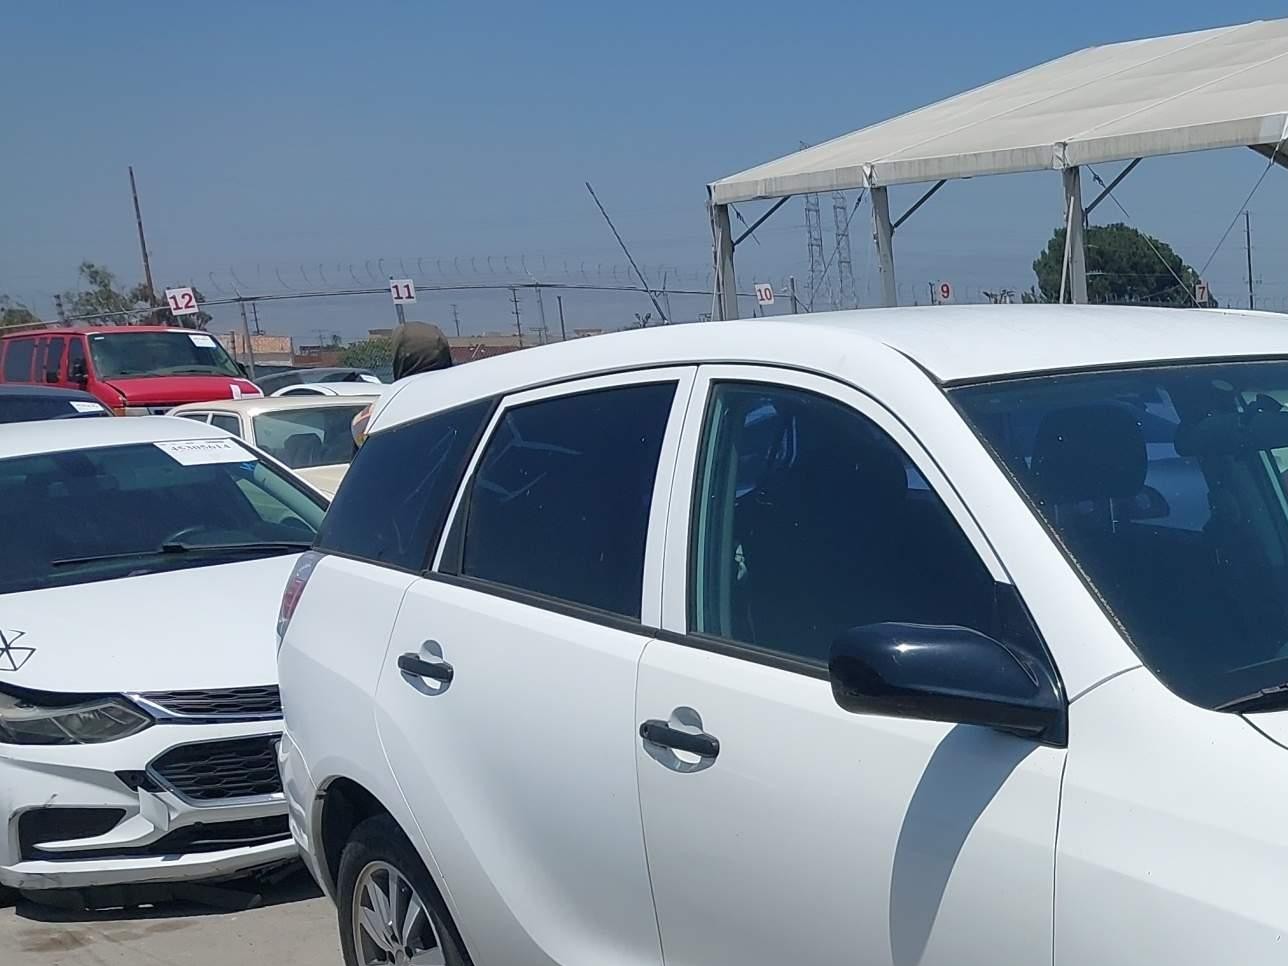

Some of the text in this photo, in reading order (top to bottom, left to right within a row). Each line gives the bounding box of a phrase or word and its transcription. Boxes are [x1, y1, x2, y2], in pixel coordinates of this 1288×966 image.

[392, 284, 414, 300] 11
[757, 288, 772, 301] 10
[941, 284, 950, 298] 9
[1199, 286, 1206, 300] 7
[169, 293, 195, 311] 12
